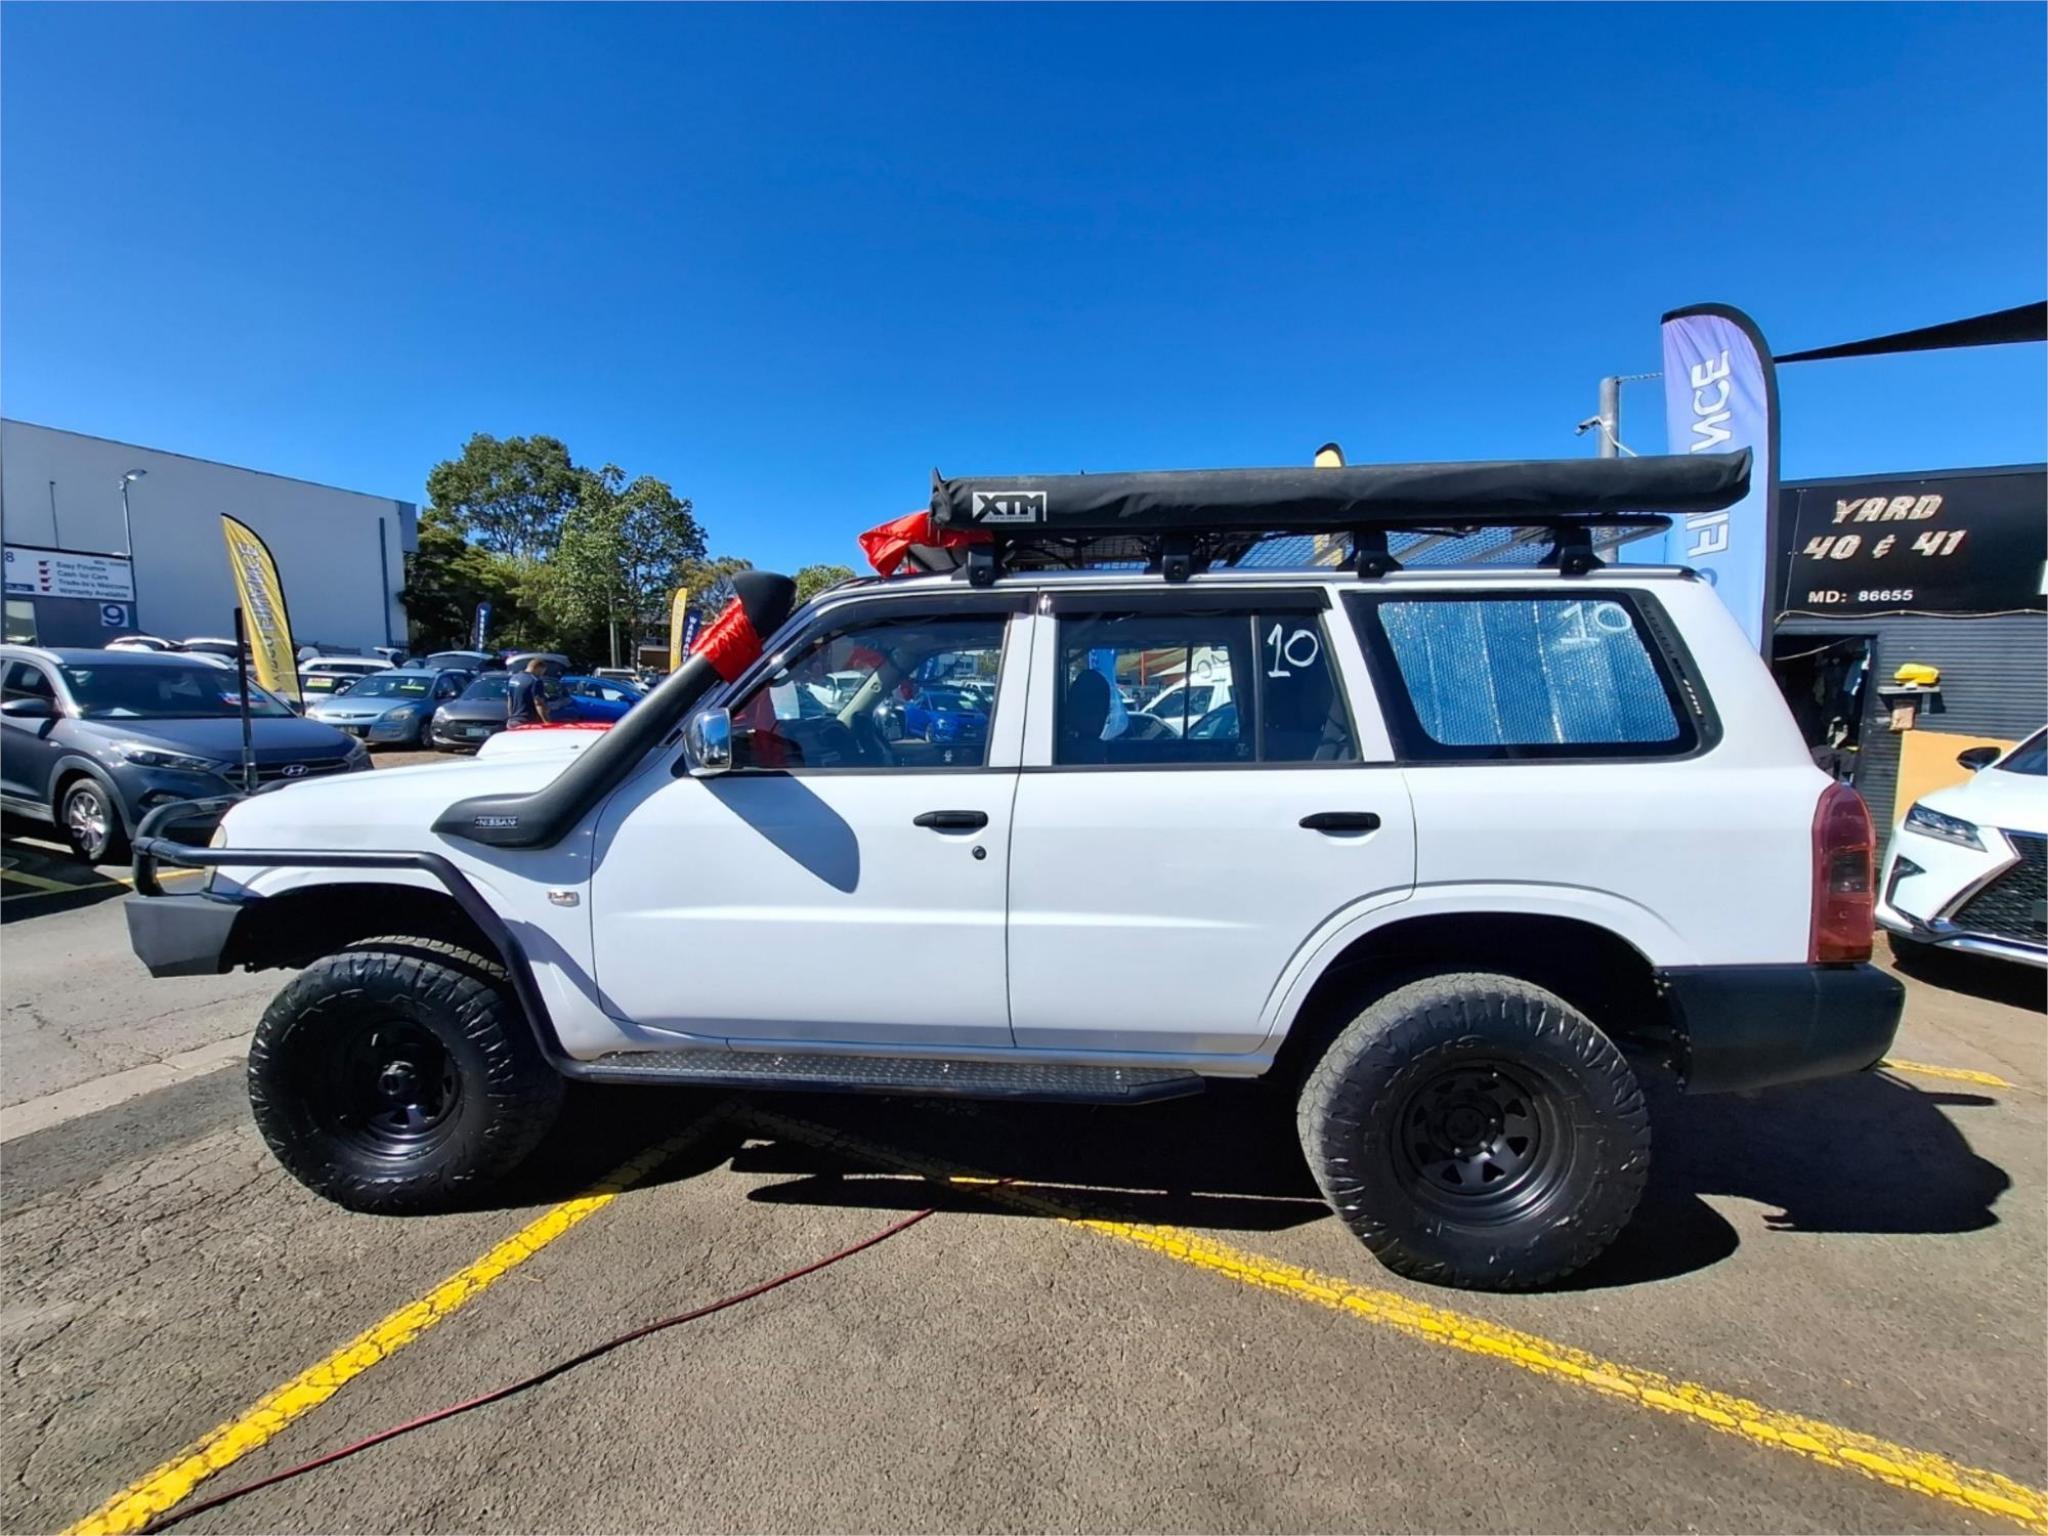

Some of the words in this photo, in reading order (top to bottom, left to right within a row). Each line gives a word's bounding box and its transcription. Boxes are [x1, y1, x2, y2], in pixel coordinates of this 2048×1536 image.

[973, 495, 1044, 522] XTM
[1832, 494, 1944, 524] YARD
[1803, 534, 1862, 560] 40
[1911, 529, 1968, 557] 41
[77, 563, 107, 572] Finance
[1808, 590, 1847, 603] MD:
[1858, 589, 1914, 602] 86655
[102, 604, 126, 627] 9
[1560, 602, 1633, 644] 10
[1267, 623, 1320, 678] 10
[479, 818, 517, 826] NISSAN
